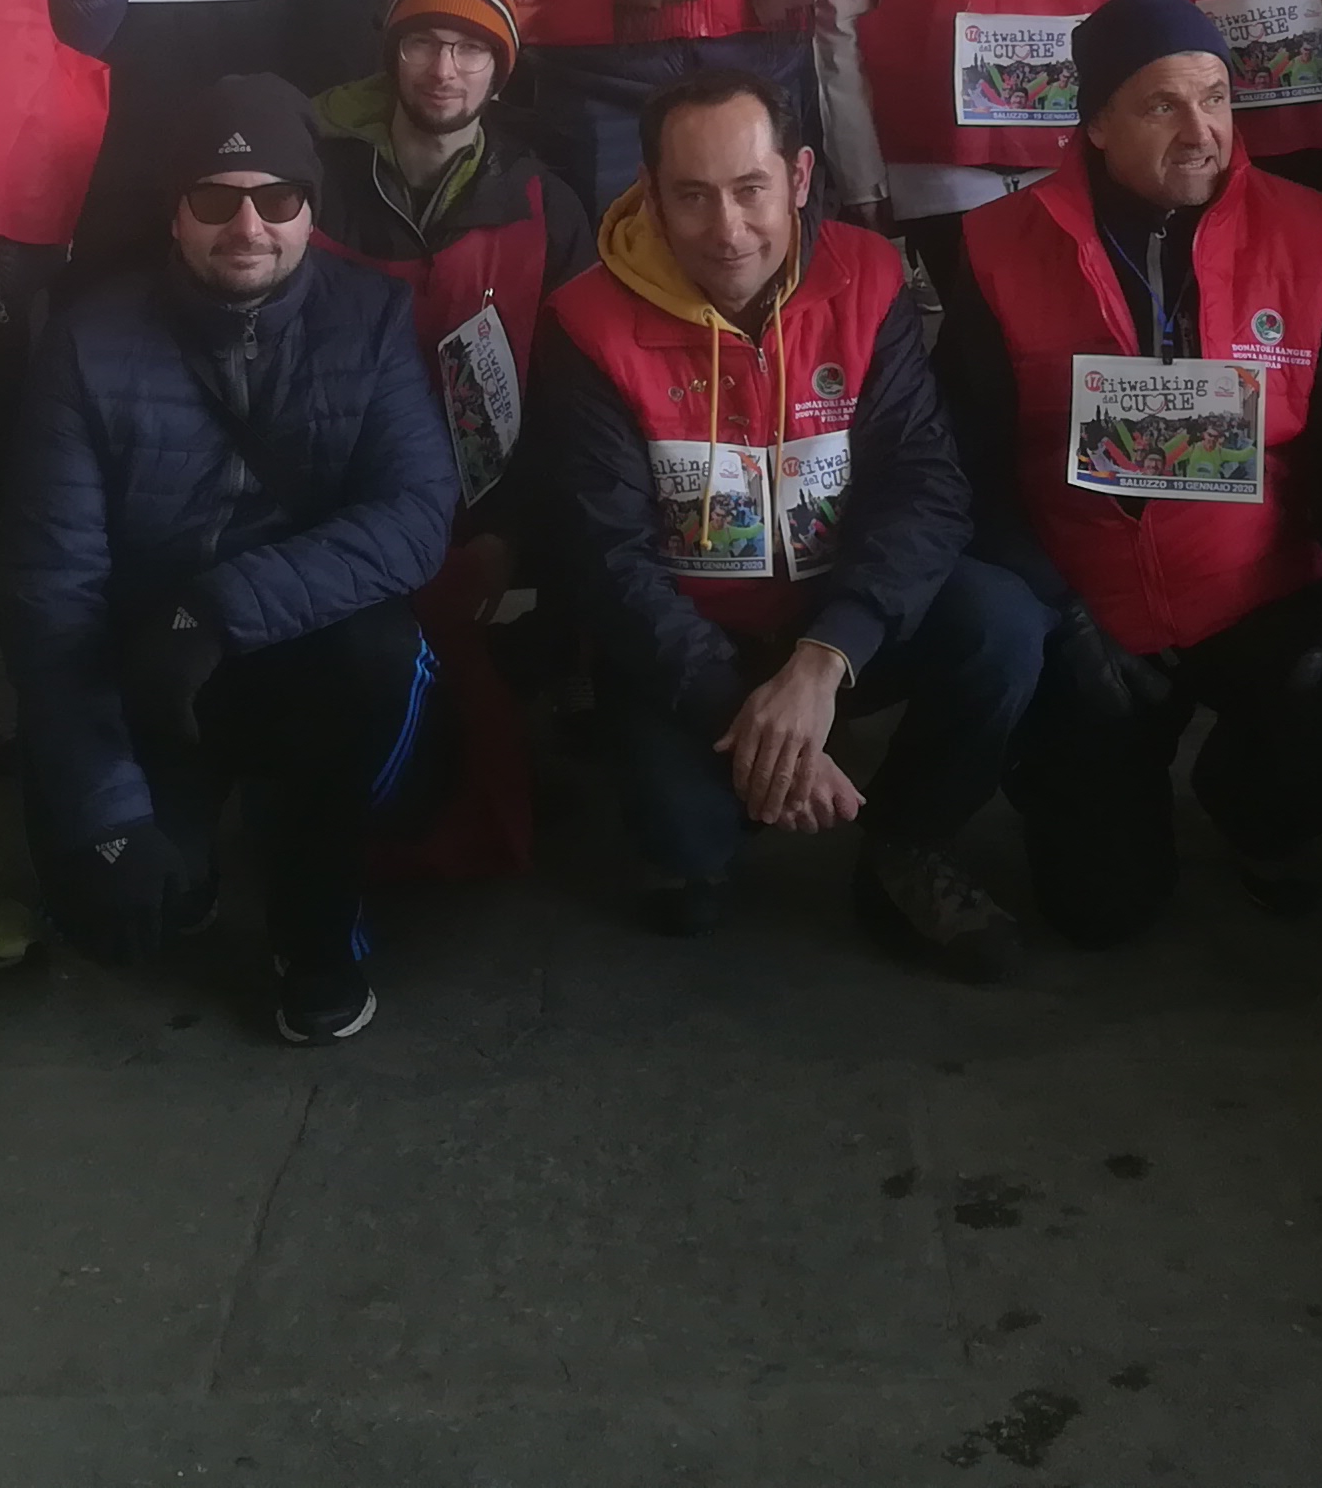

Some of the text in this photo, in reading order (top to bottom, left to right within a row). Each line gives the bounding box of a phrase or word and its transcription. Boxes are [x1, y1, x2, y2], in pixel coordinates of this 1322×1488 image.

[977, 30, 1066, 47] fitwalking
[979, 44, 992, 52] del
[1239, 92, 1276, 101] SALUZZO
[1276, 347, 1312, 357] SANGUE
[1100, 376, 1209, 397] fitwalking
[1102, 394, 1118, 404] del
[798, 449, 850, 477] fitwal
[802, 476, 820, 486] del
[1120, 478, 1254, 493] SALUZZO 19 GENNAIO 2020
[702, 562, 741, 570] GENNAIO
[742, 561, 763, 570] 2020
